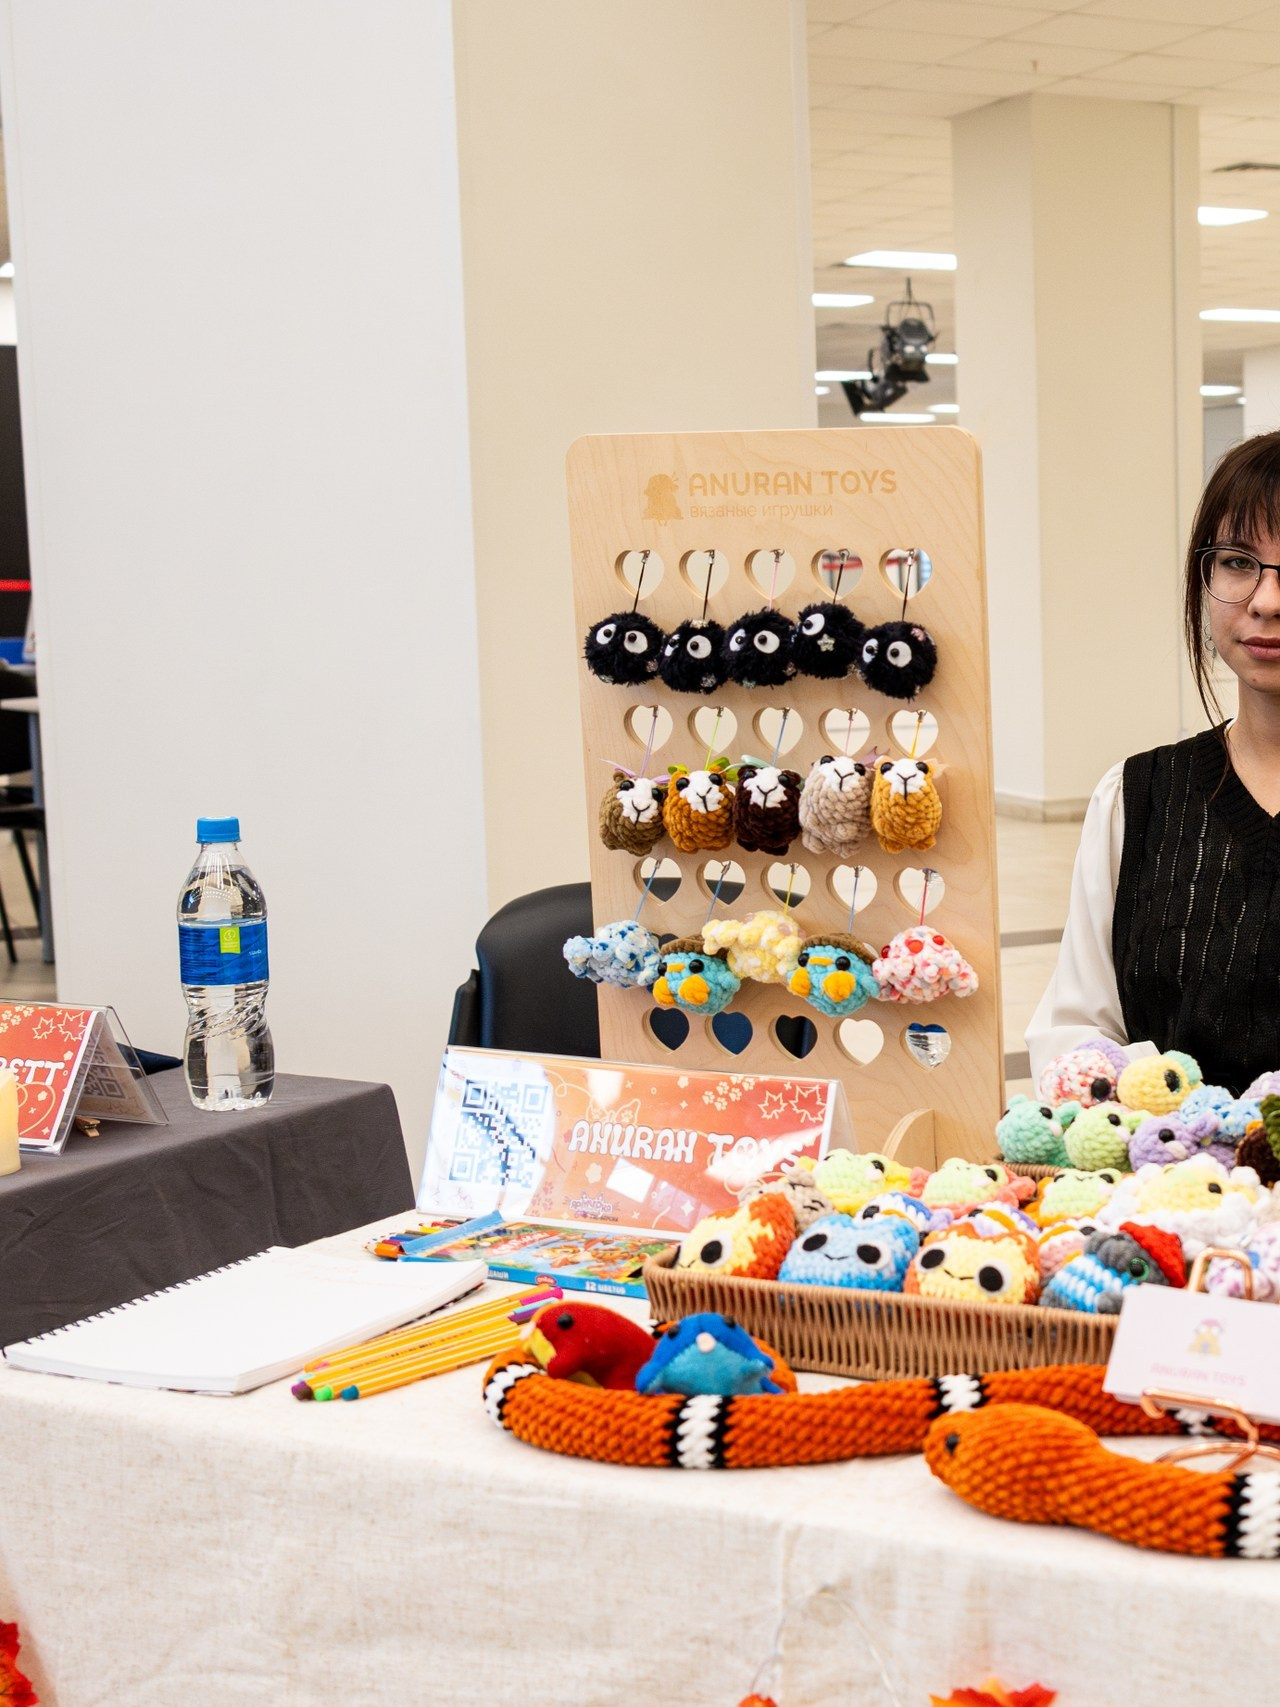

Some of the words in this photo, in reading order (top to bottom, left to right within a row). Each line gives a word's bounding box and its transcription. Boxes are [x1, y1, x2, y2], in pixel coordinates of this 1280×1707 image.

[689, 471, 812, 497] ANURAN
[821, 469, 898, 495] TOYS
[690, 505, 756, 518] вязаные
[762, 503, 833, 520] игрушки
[568, 1119, 699, 1164] ANURAN
